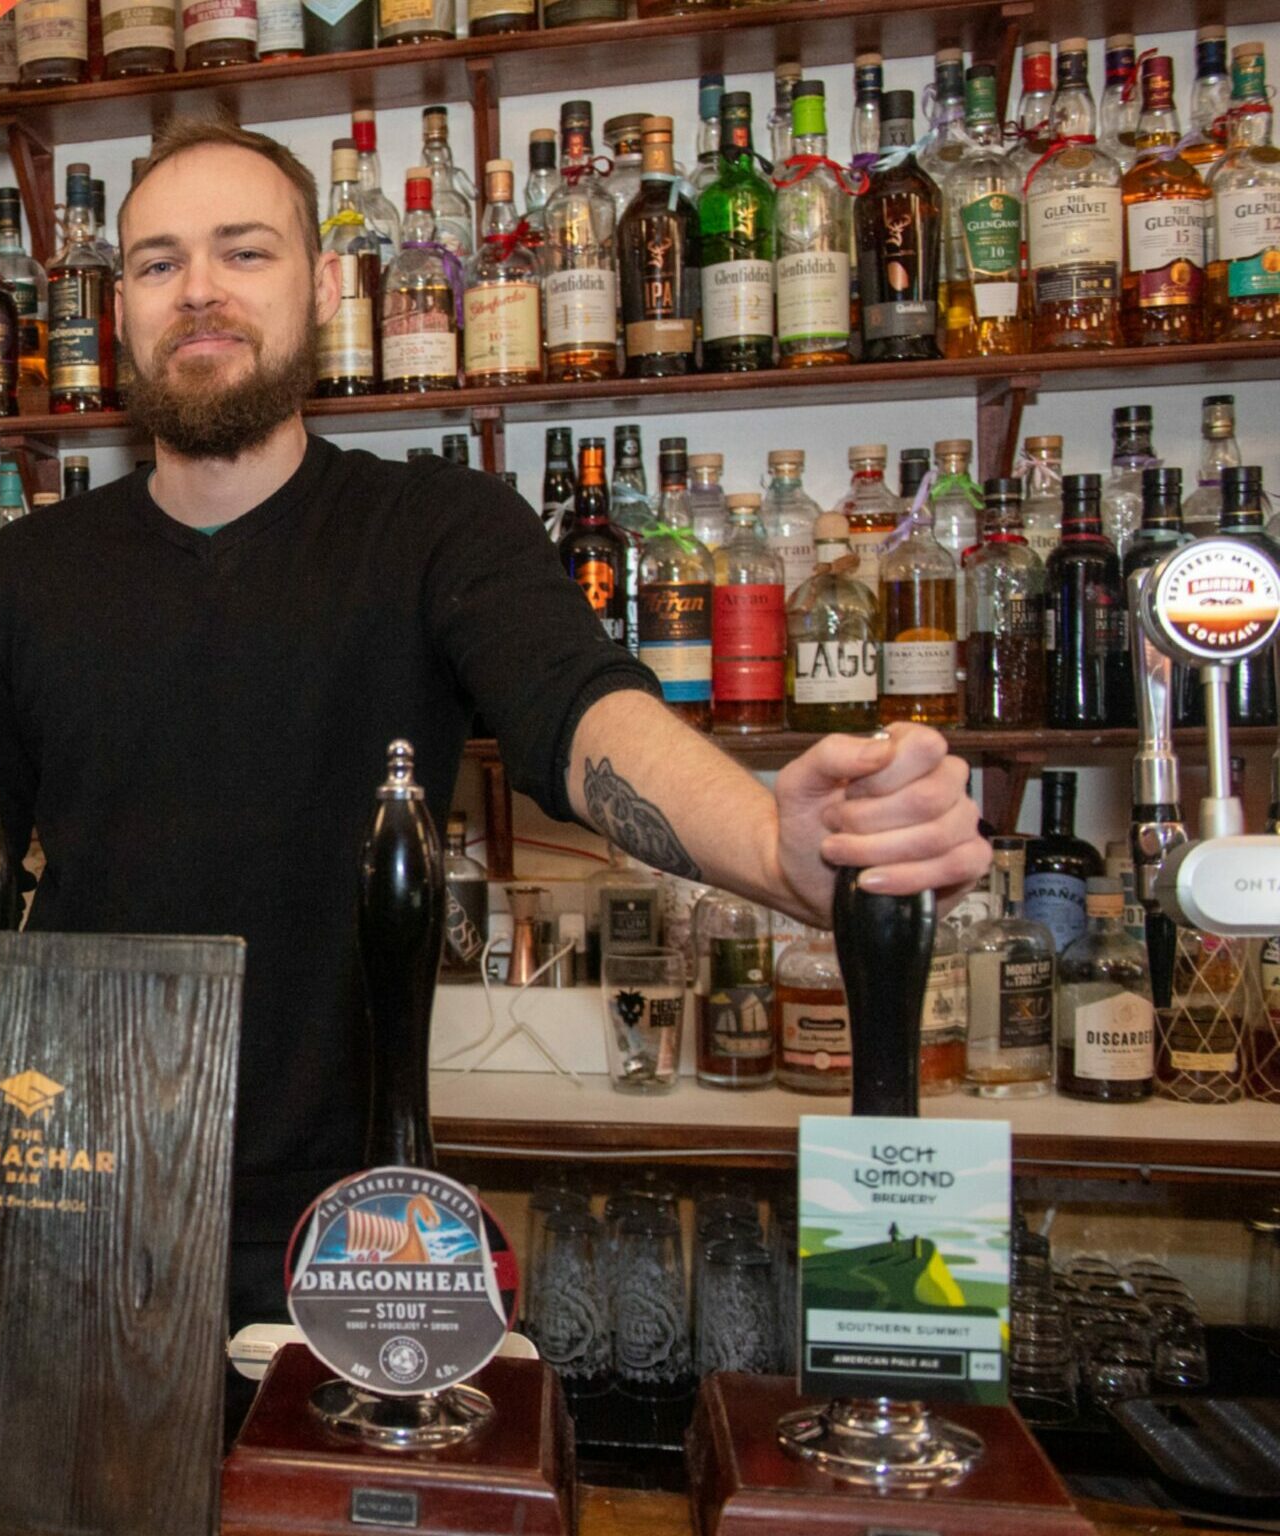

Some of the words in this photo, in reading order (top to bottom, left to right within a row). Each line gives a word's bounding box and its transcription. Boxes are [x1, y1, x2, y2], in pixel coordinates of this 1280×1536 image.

[1067, 195, 1086, 204] THE
[1044, 202, 1107, 220] GLENLIVET
[1172, 205, 1190, 215] THE
[1264, 217, 1280, 230] 12
[1175, 230, 1190, 243] 15
[990, 247, 1006, 258] 10
[645, 282, 671, 306] IPA
[1187, 622, 1260, 645] COCKTAIL
[795, 643, 877, 679] LAGG
[1234, 879, 1262, 892] ON
[1006, 962, 1037, 976] MOUNT
[11, 1128, 42, 1141] THE
[872, 1145, 936, 1165] LOCH
[5, 1171, 40, 1184] BAR
[854, 1168, 955, 1188] LOMOND
[320, 1199, 344, 1219] THE
[349, 1177, 405, 1198] ORKNEY
[411, 1178, 475, 1219] BREWERY
[872, 1193, 937, 1204] BREWERY
[376, 1303, 426, 1320] STOUT
[836, 1321, 911, 1335] SOUTHERN
[916, 1325, 971, 1337] SUMMIT
[832, 1354, 889, 1367] AMERICAN
[890, 1356, 917, 1368] PALE
[919, 1358, 940, 1369] ALE
[351, 1362, 372, 1379] ABV
